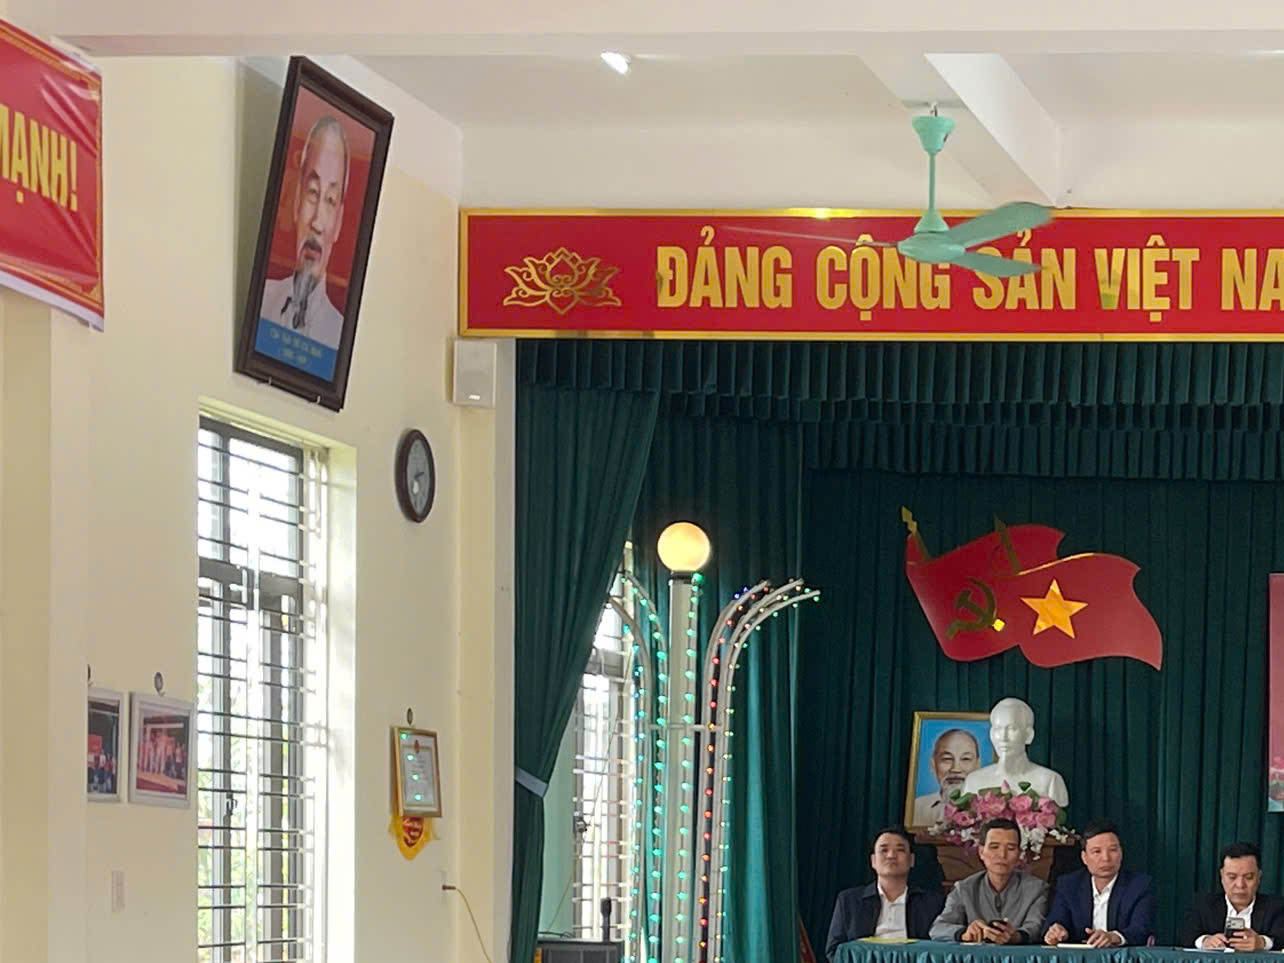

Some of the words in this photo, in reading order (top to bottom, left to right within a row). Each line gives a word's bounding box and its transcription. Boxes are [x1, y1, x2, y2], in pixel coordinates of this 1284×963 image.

[656, 225, 793, 309] ĐẢNG
[815, 233, 951, 321] CỘNG
[972, 228, 1077, 311] SẢN
[1094, 234, 1201, 322] VIỆT
